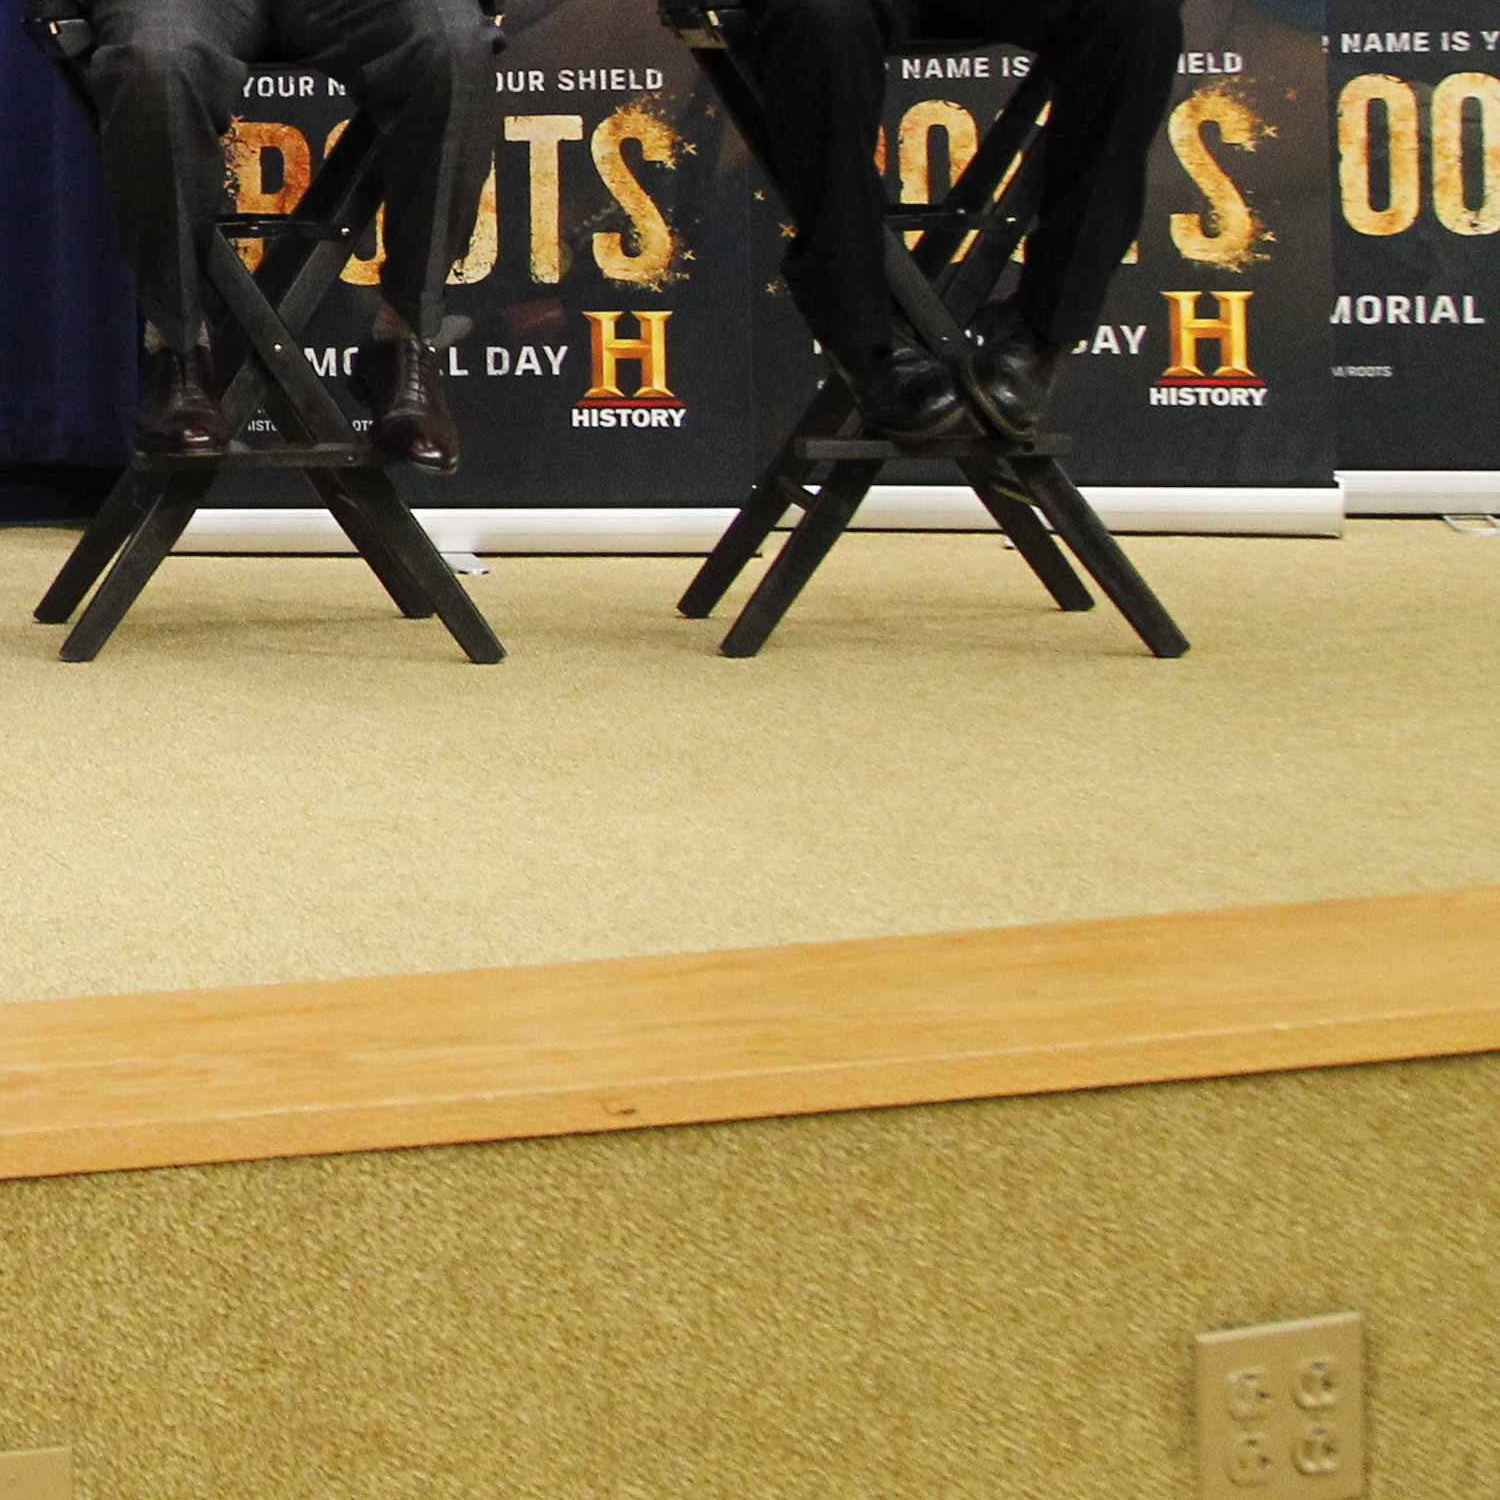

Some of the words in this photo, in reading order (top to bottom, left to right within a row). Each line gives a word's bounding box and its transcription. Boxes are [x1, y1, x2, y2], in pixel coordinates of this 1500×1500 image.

[1340, 31, 1431, 54] NAME
[1440, 30, 1473, 52] IS
[902, 56, 991, 79] NAME
[1001, 55, 1031, 78] IS
[557, 68, 664, 92] SHIELD
[486, 345, 568, 377] DAY
[1149, 386, 1268, 407] HISTORY
[571, 407, 687, 429] HISTORY
